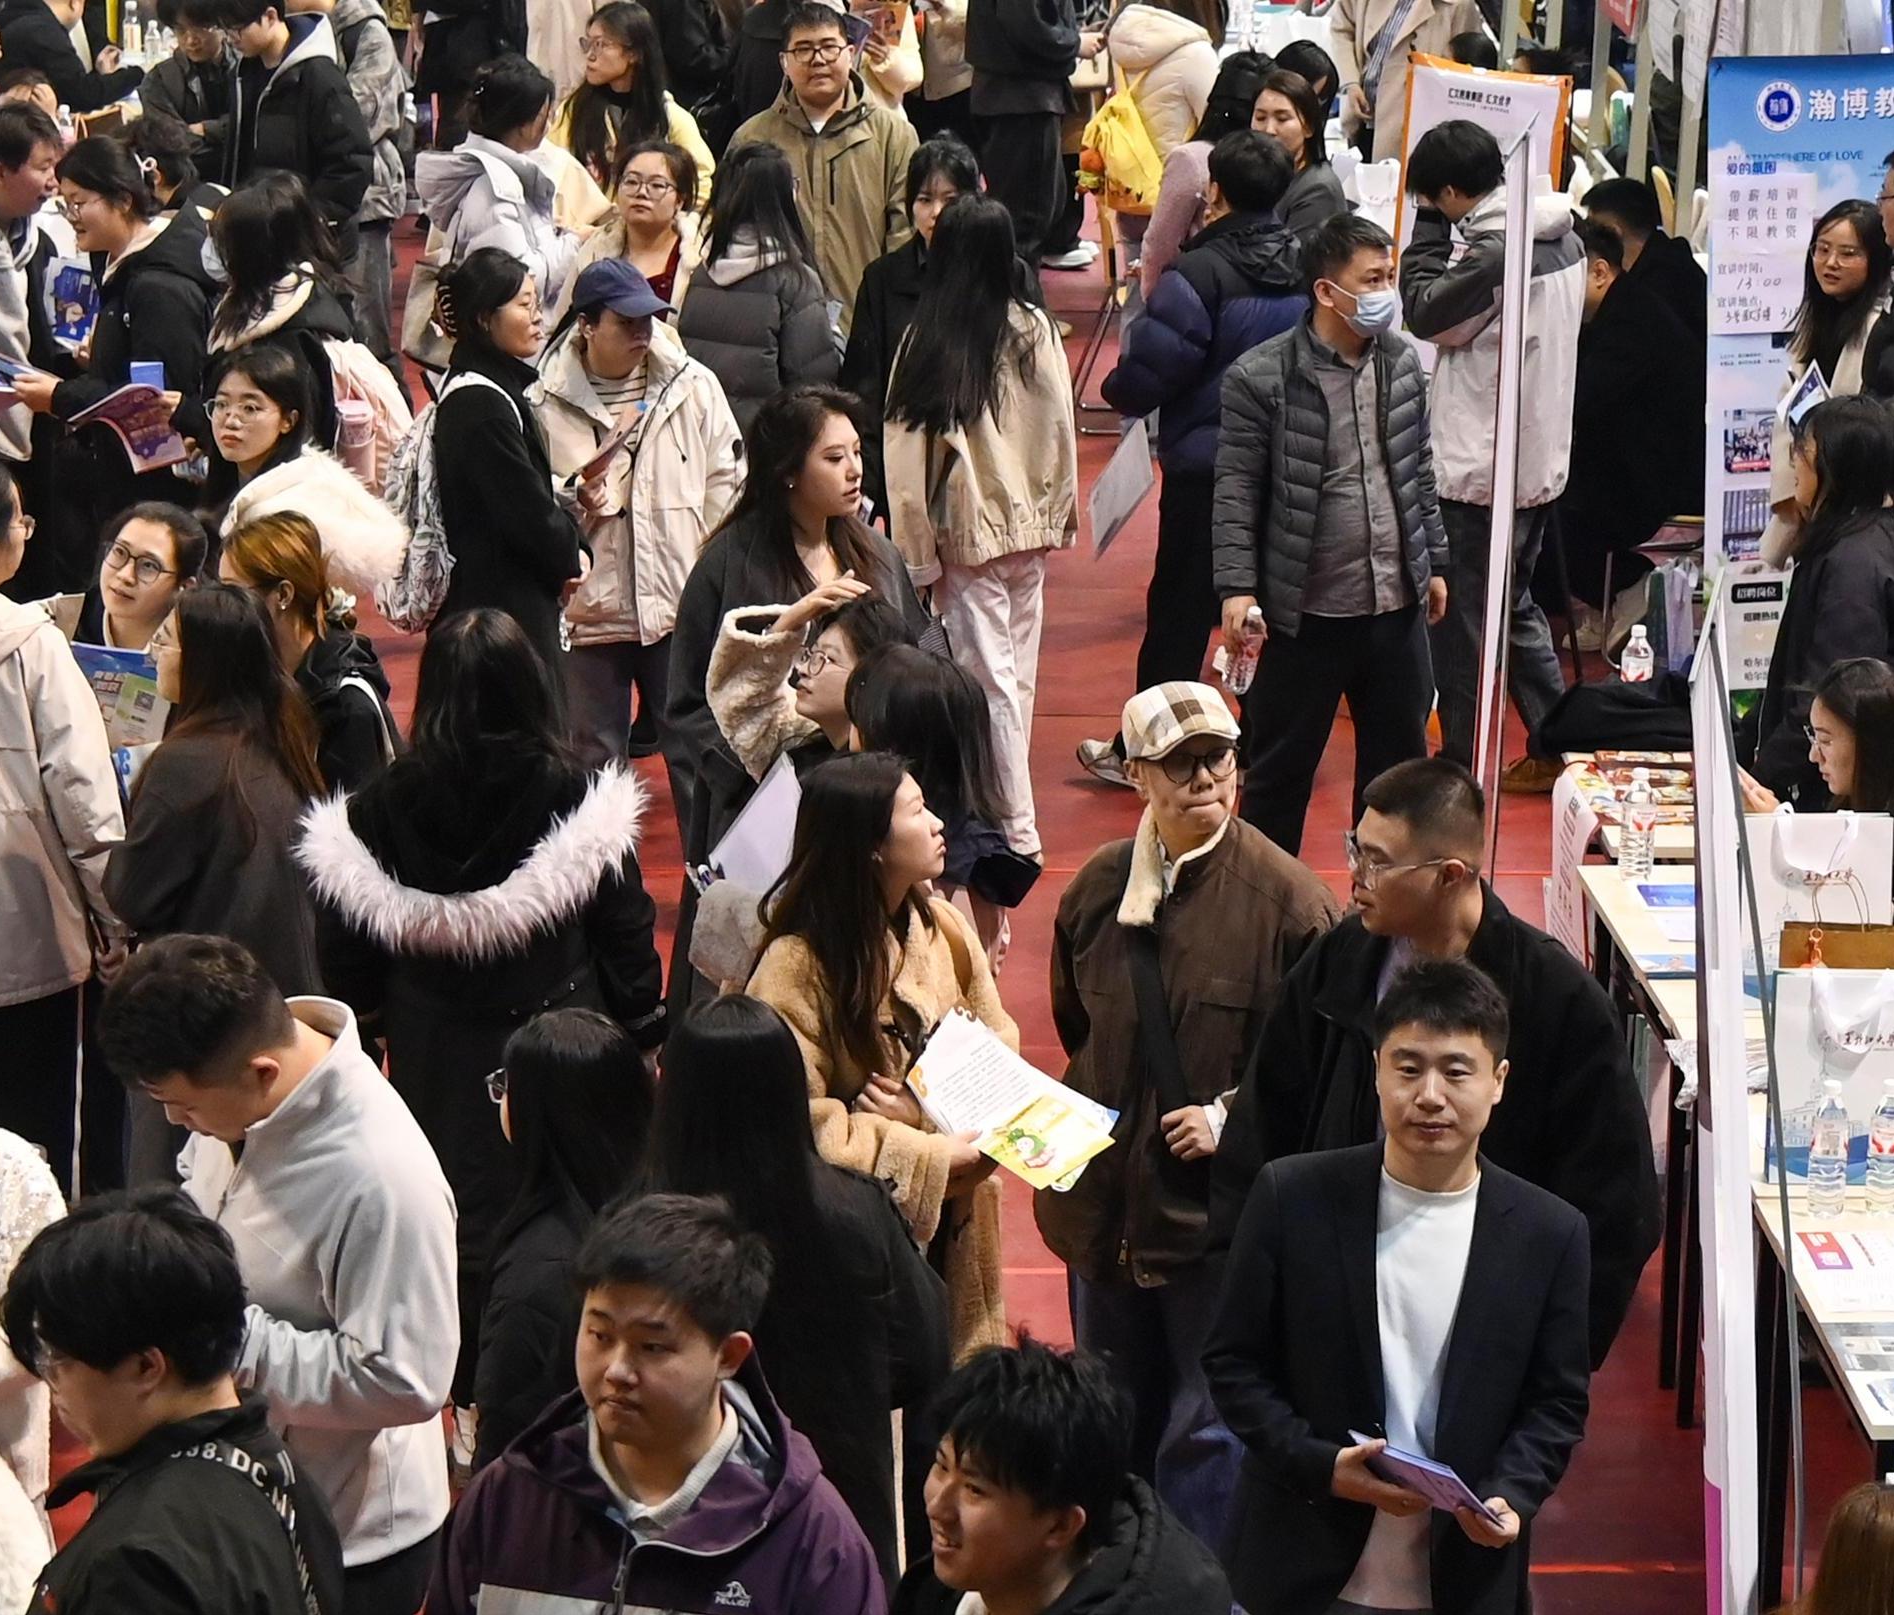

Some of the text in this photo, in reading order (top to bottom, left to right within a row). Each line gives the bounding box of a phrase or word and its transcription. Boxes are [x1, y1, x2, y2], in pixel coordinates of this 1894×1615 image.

[1835, 150, 1863, 161] LOVE
[1726, 161, 1776, 176] 爱的氛围
[1736, 585, 1777, 600] 招聘岗位
